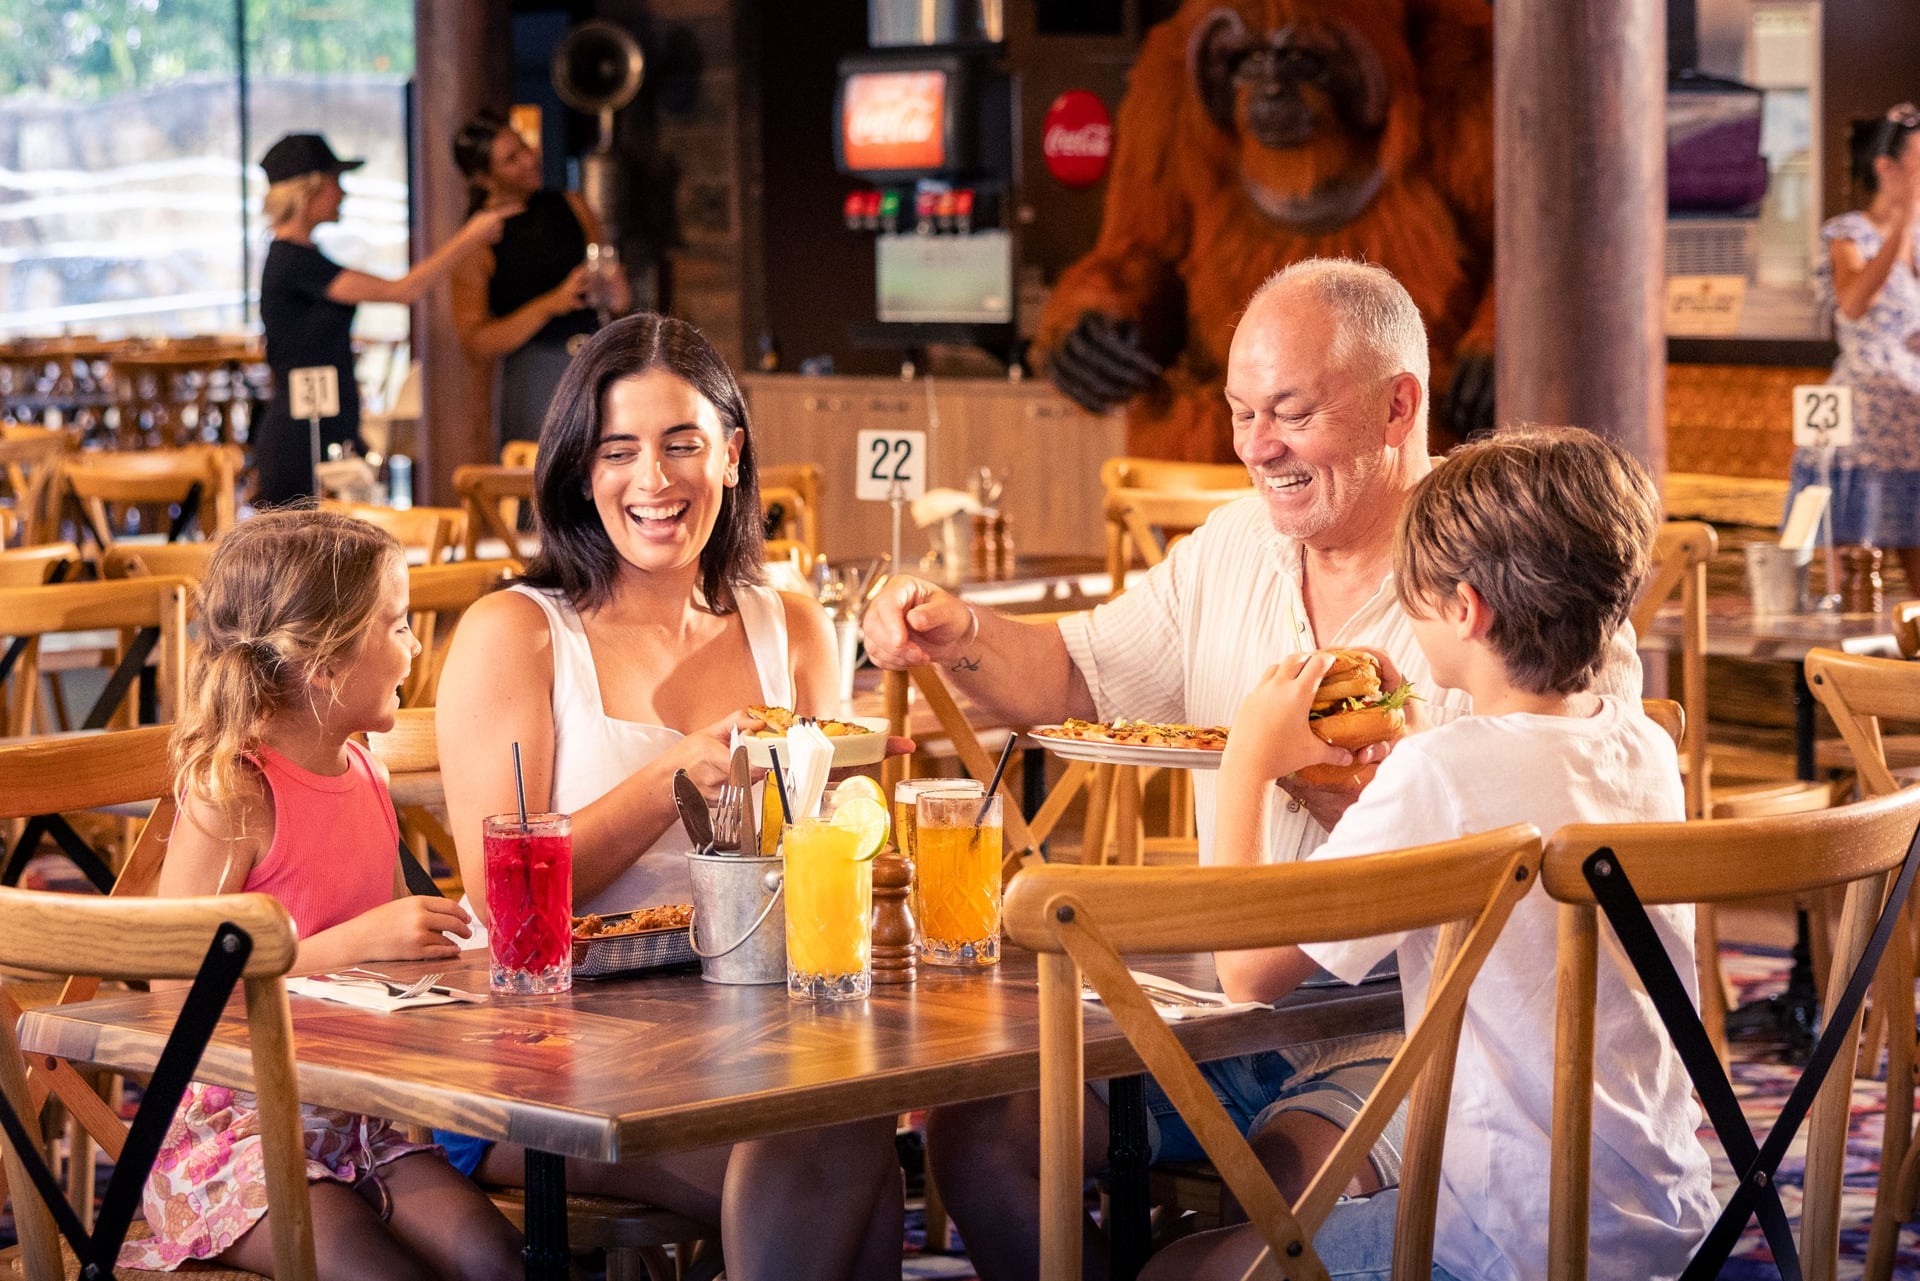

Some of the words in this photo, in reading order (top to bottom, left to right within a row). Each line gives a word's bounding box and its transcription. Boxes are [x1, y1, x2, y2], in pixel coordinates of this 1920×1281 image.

[303, 375, 327, 404] 31
[1806, 393, 1839, 429] 23
[871, 438, 911, 480] 22
